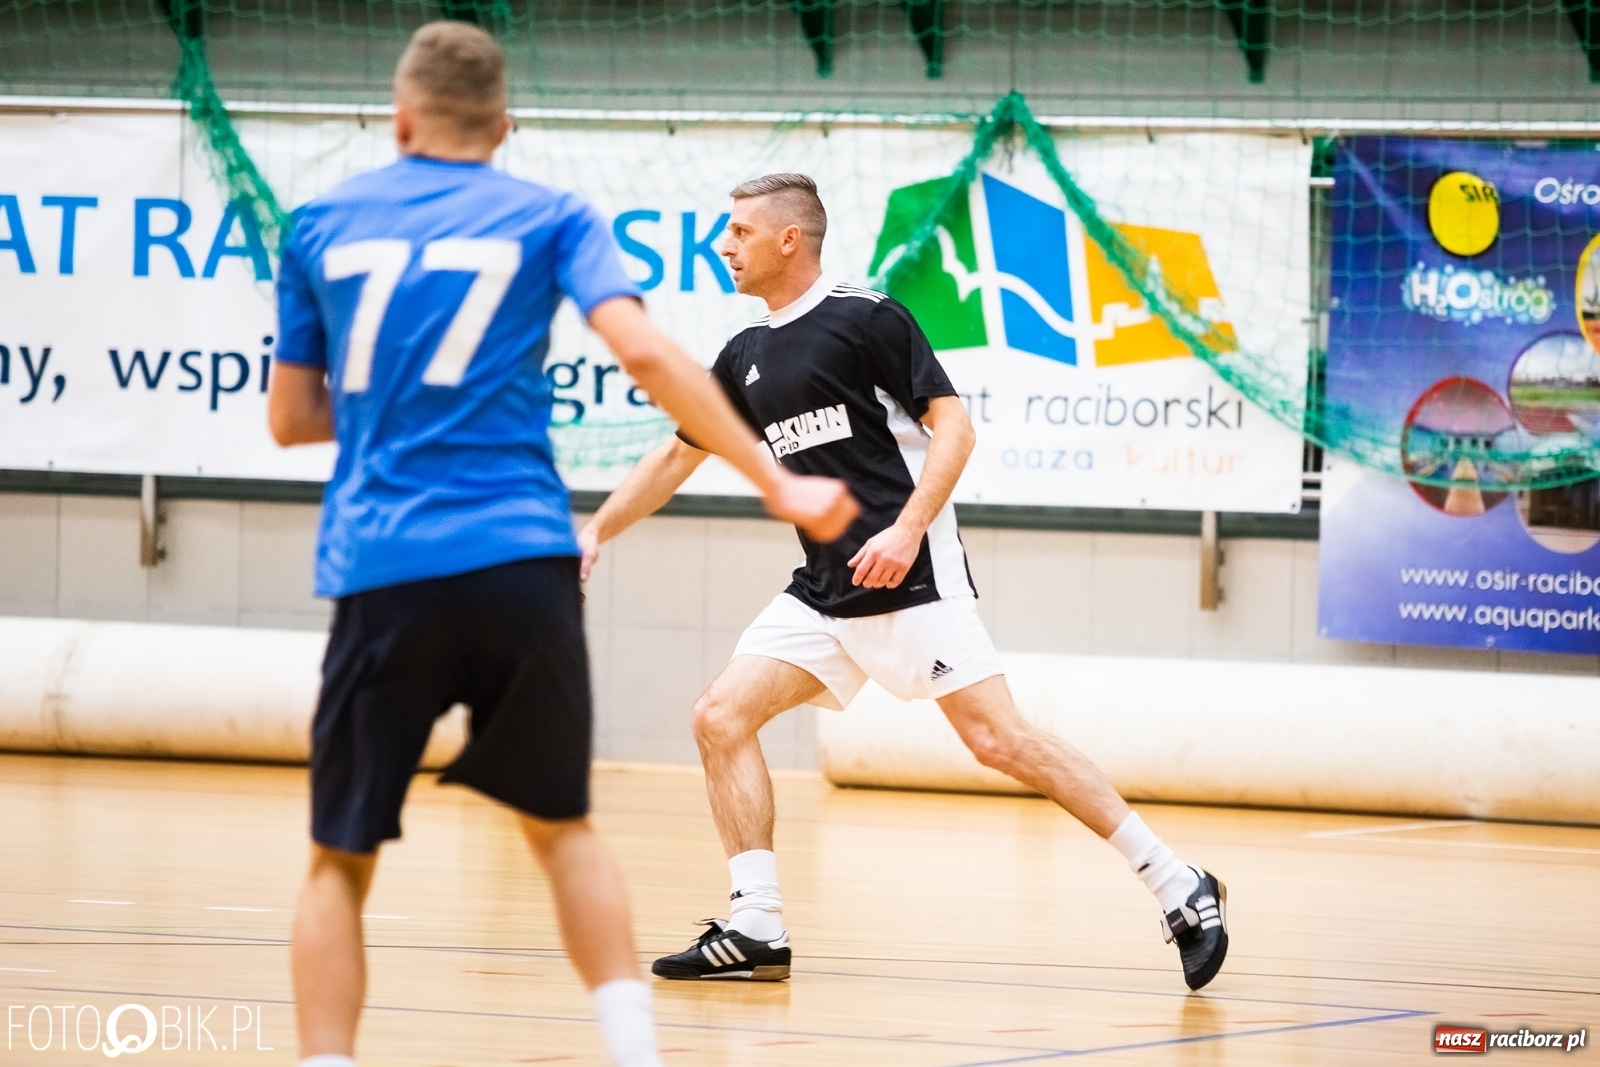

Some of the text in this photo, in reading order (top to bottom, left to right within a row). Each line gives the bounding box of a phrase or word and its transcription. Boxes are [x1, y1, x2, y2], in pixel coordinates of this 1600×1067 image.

[323, 238, 521, 393] 77
[779, 404, 850, 441] KUHN
[1025, 384, 1243, 430] raciborski
[1001, 441, 1242, 475] oaza kultur
